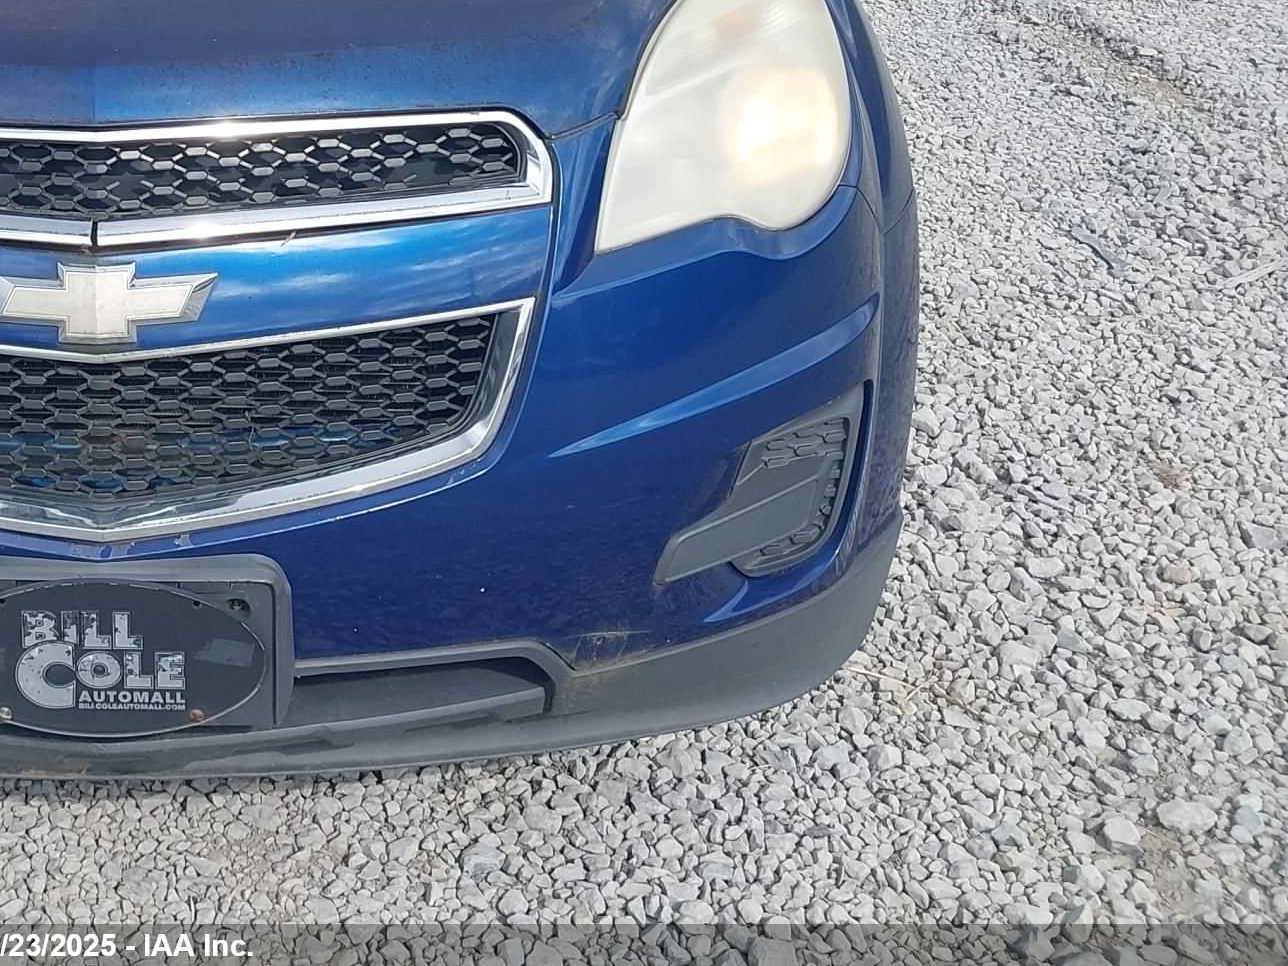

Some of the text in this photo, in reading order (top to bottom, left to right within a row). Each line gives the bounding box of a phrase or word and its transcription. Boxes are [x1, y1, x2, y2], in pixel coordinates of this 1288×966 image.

[21, 610, 144, 650] BILL
[15, 641, 186, 708] COLE
[78, 690, 186, 704] AUTOMALL
